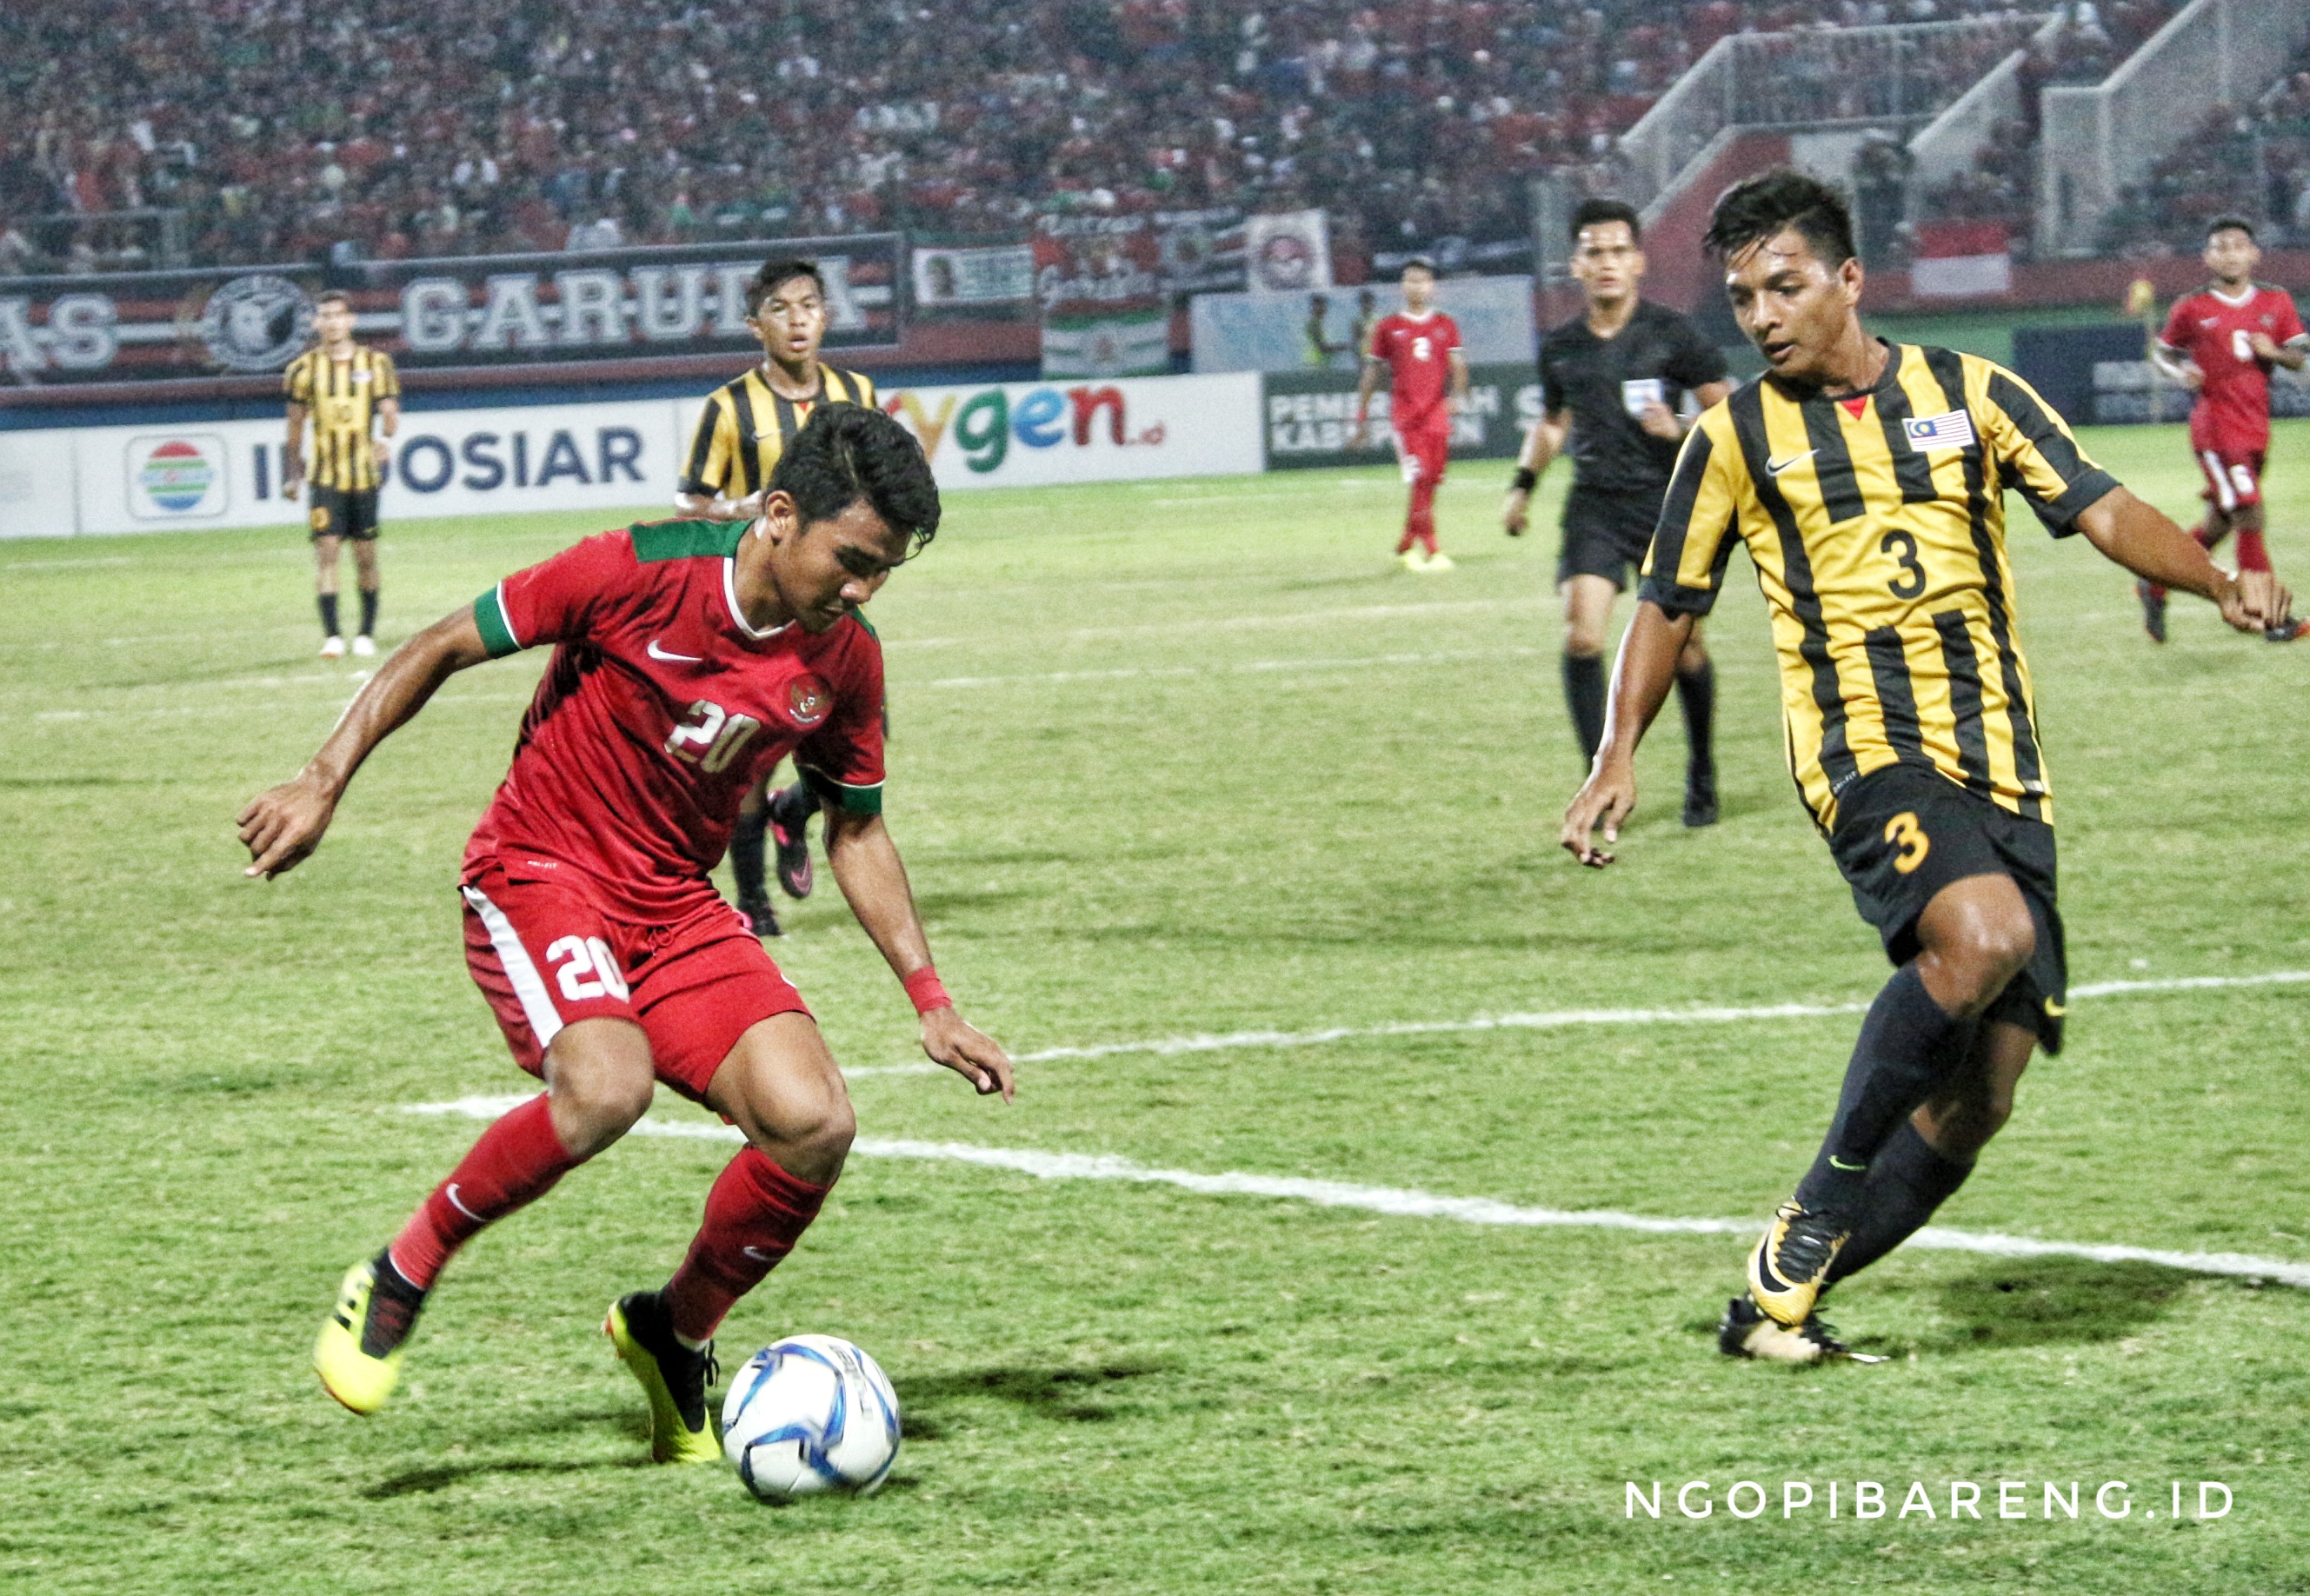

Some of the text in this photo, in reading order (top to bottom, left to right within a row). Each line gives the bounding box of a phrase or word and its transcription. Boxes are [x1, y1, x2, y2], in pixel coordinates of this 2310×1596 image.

[253, 424, 646, 502] IOSIAR
[884, 386, 1167, 474] ygen.id
[1880, 529, 1927, 600] 3
[664, 699, 760, 774] 20
[1884, 811, 1930, 874] 3
[545, 934, 630, 1001] 20
